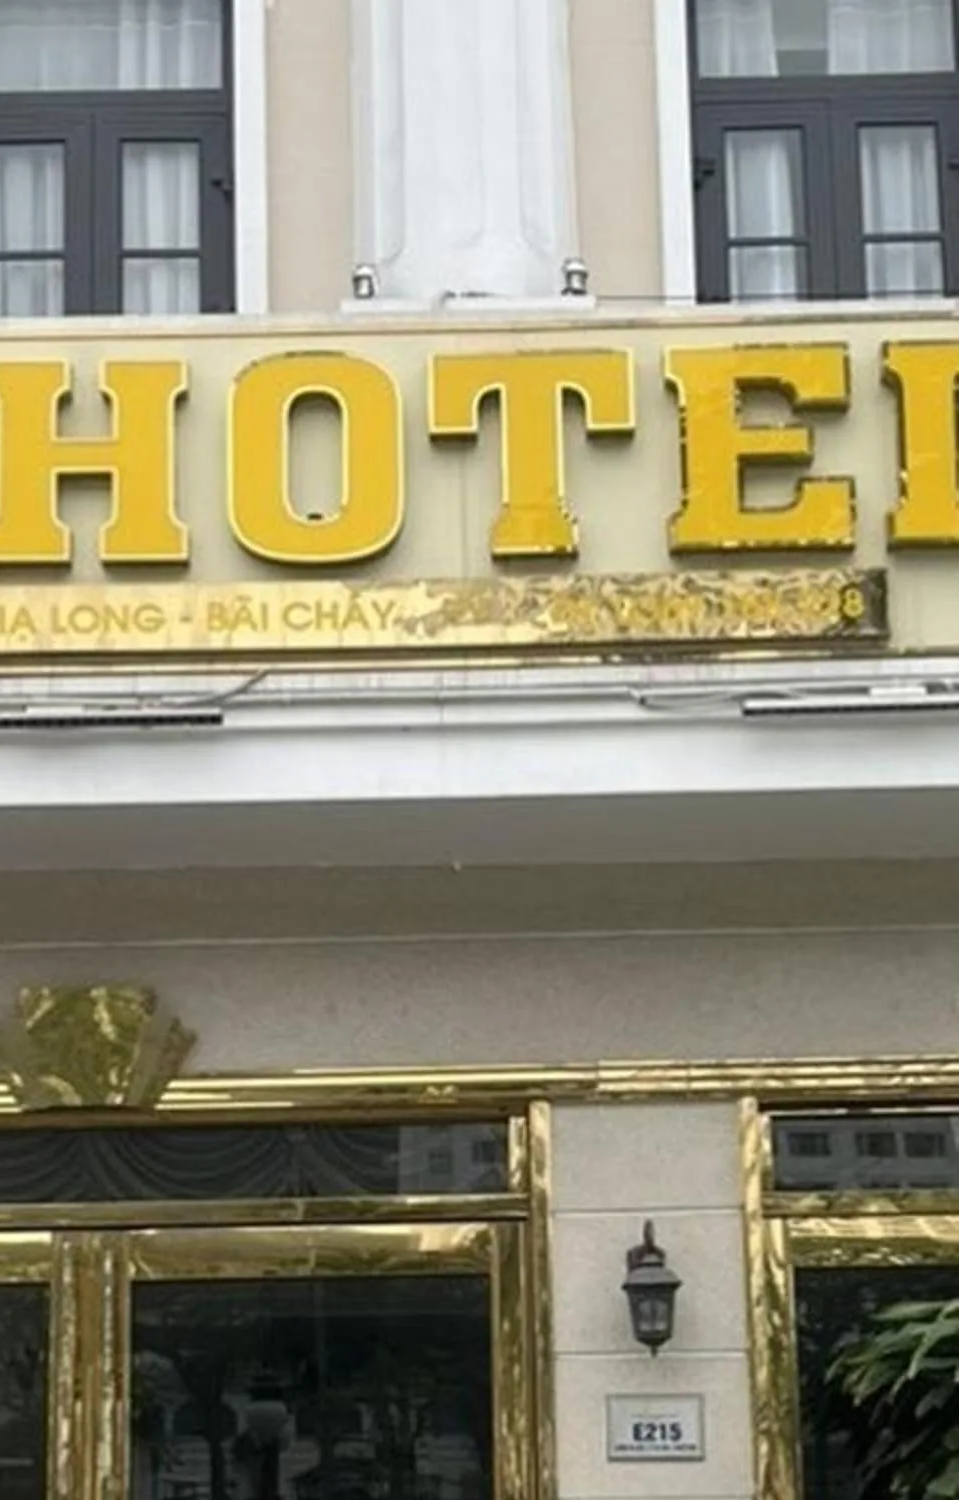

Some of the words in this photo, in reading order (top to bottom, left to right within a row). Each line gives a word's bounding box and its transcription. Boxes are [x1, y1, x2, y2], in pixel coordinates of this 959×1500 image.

[50, 601, 166, 634] LONG
[206, 595, 269, 632] BÃI
[282, 590, 397, 631] CHÁY
[632, 1421, 683, 1442] E215
